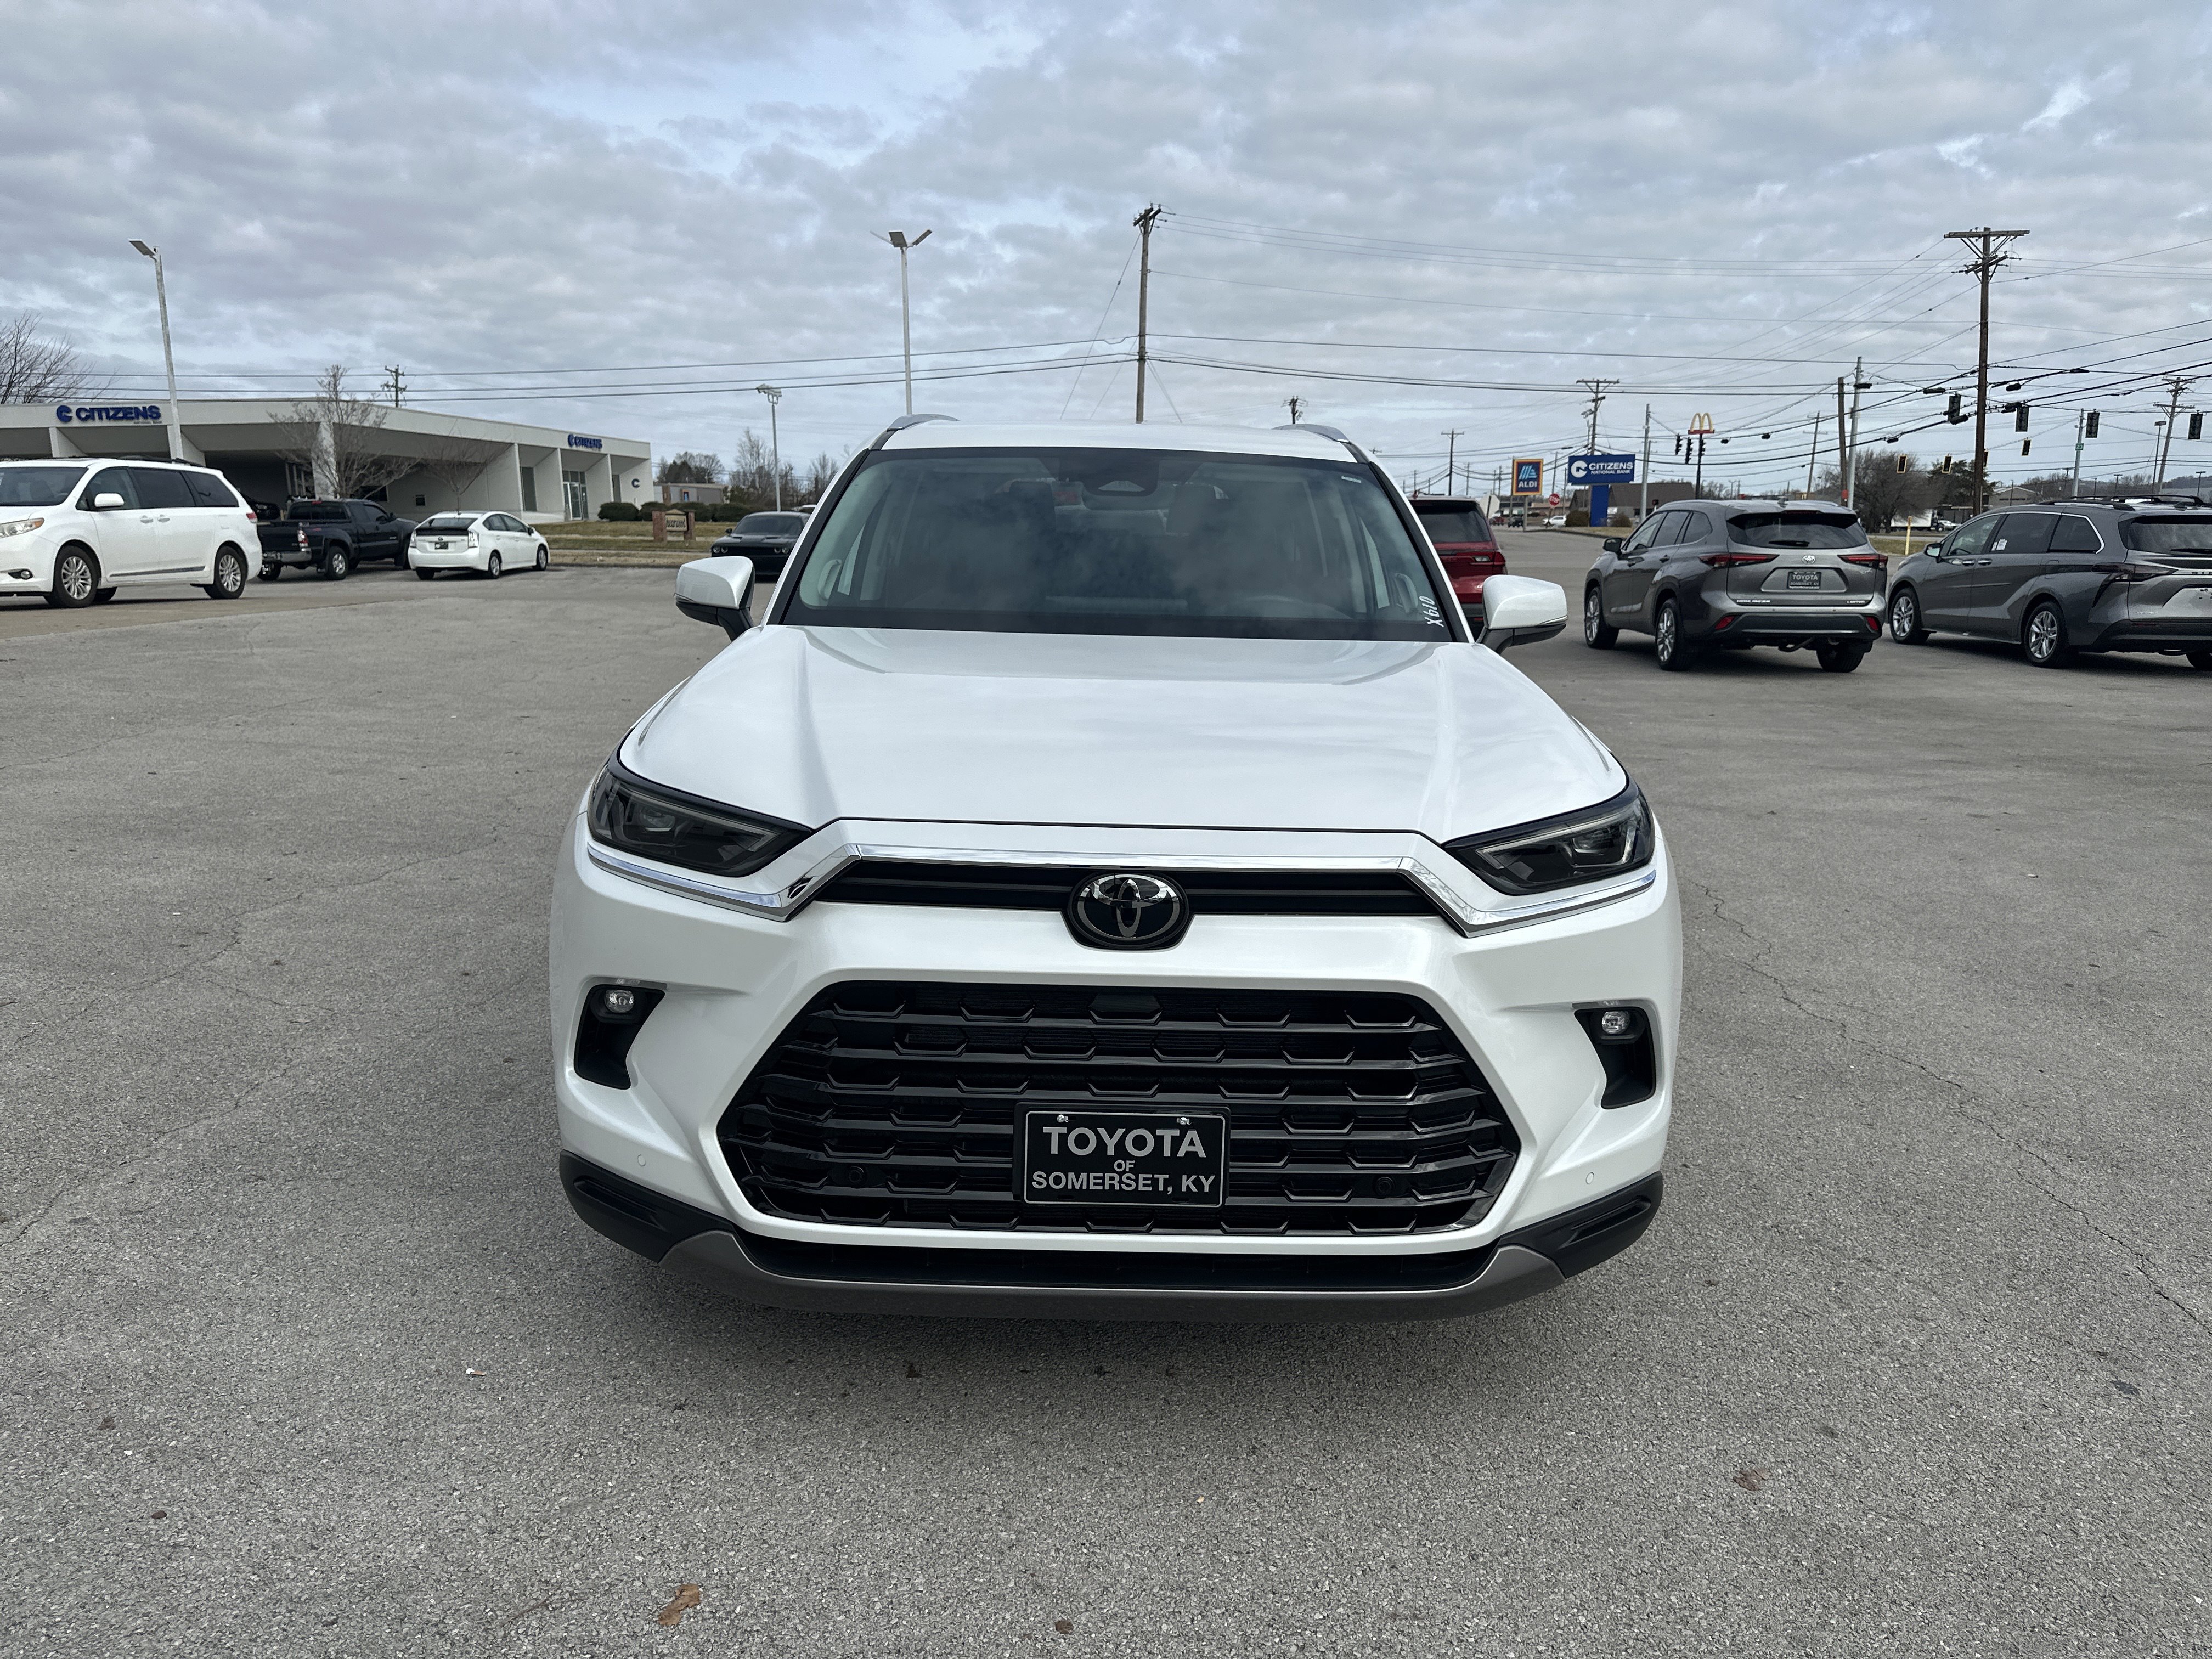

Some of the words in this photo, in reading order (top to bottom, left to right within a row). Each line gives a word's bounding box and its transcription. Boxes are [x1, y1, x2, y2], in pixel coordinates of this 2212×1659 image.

[76, 405, 161, 421] CITIZENS
[1588, 462, 1633, 470] CITIZENS
[1419, 596, 1444, 627] X610
[1043, 1126, 1206, 1158] TOYOTA
[1114, 1160, 1135, 1172] OF
[1032, 1171, 1173, 1195] SOMERSET,
[1182, 1175, 1215, 1193] KY
